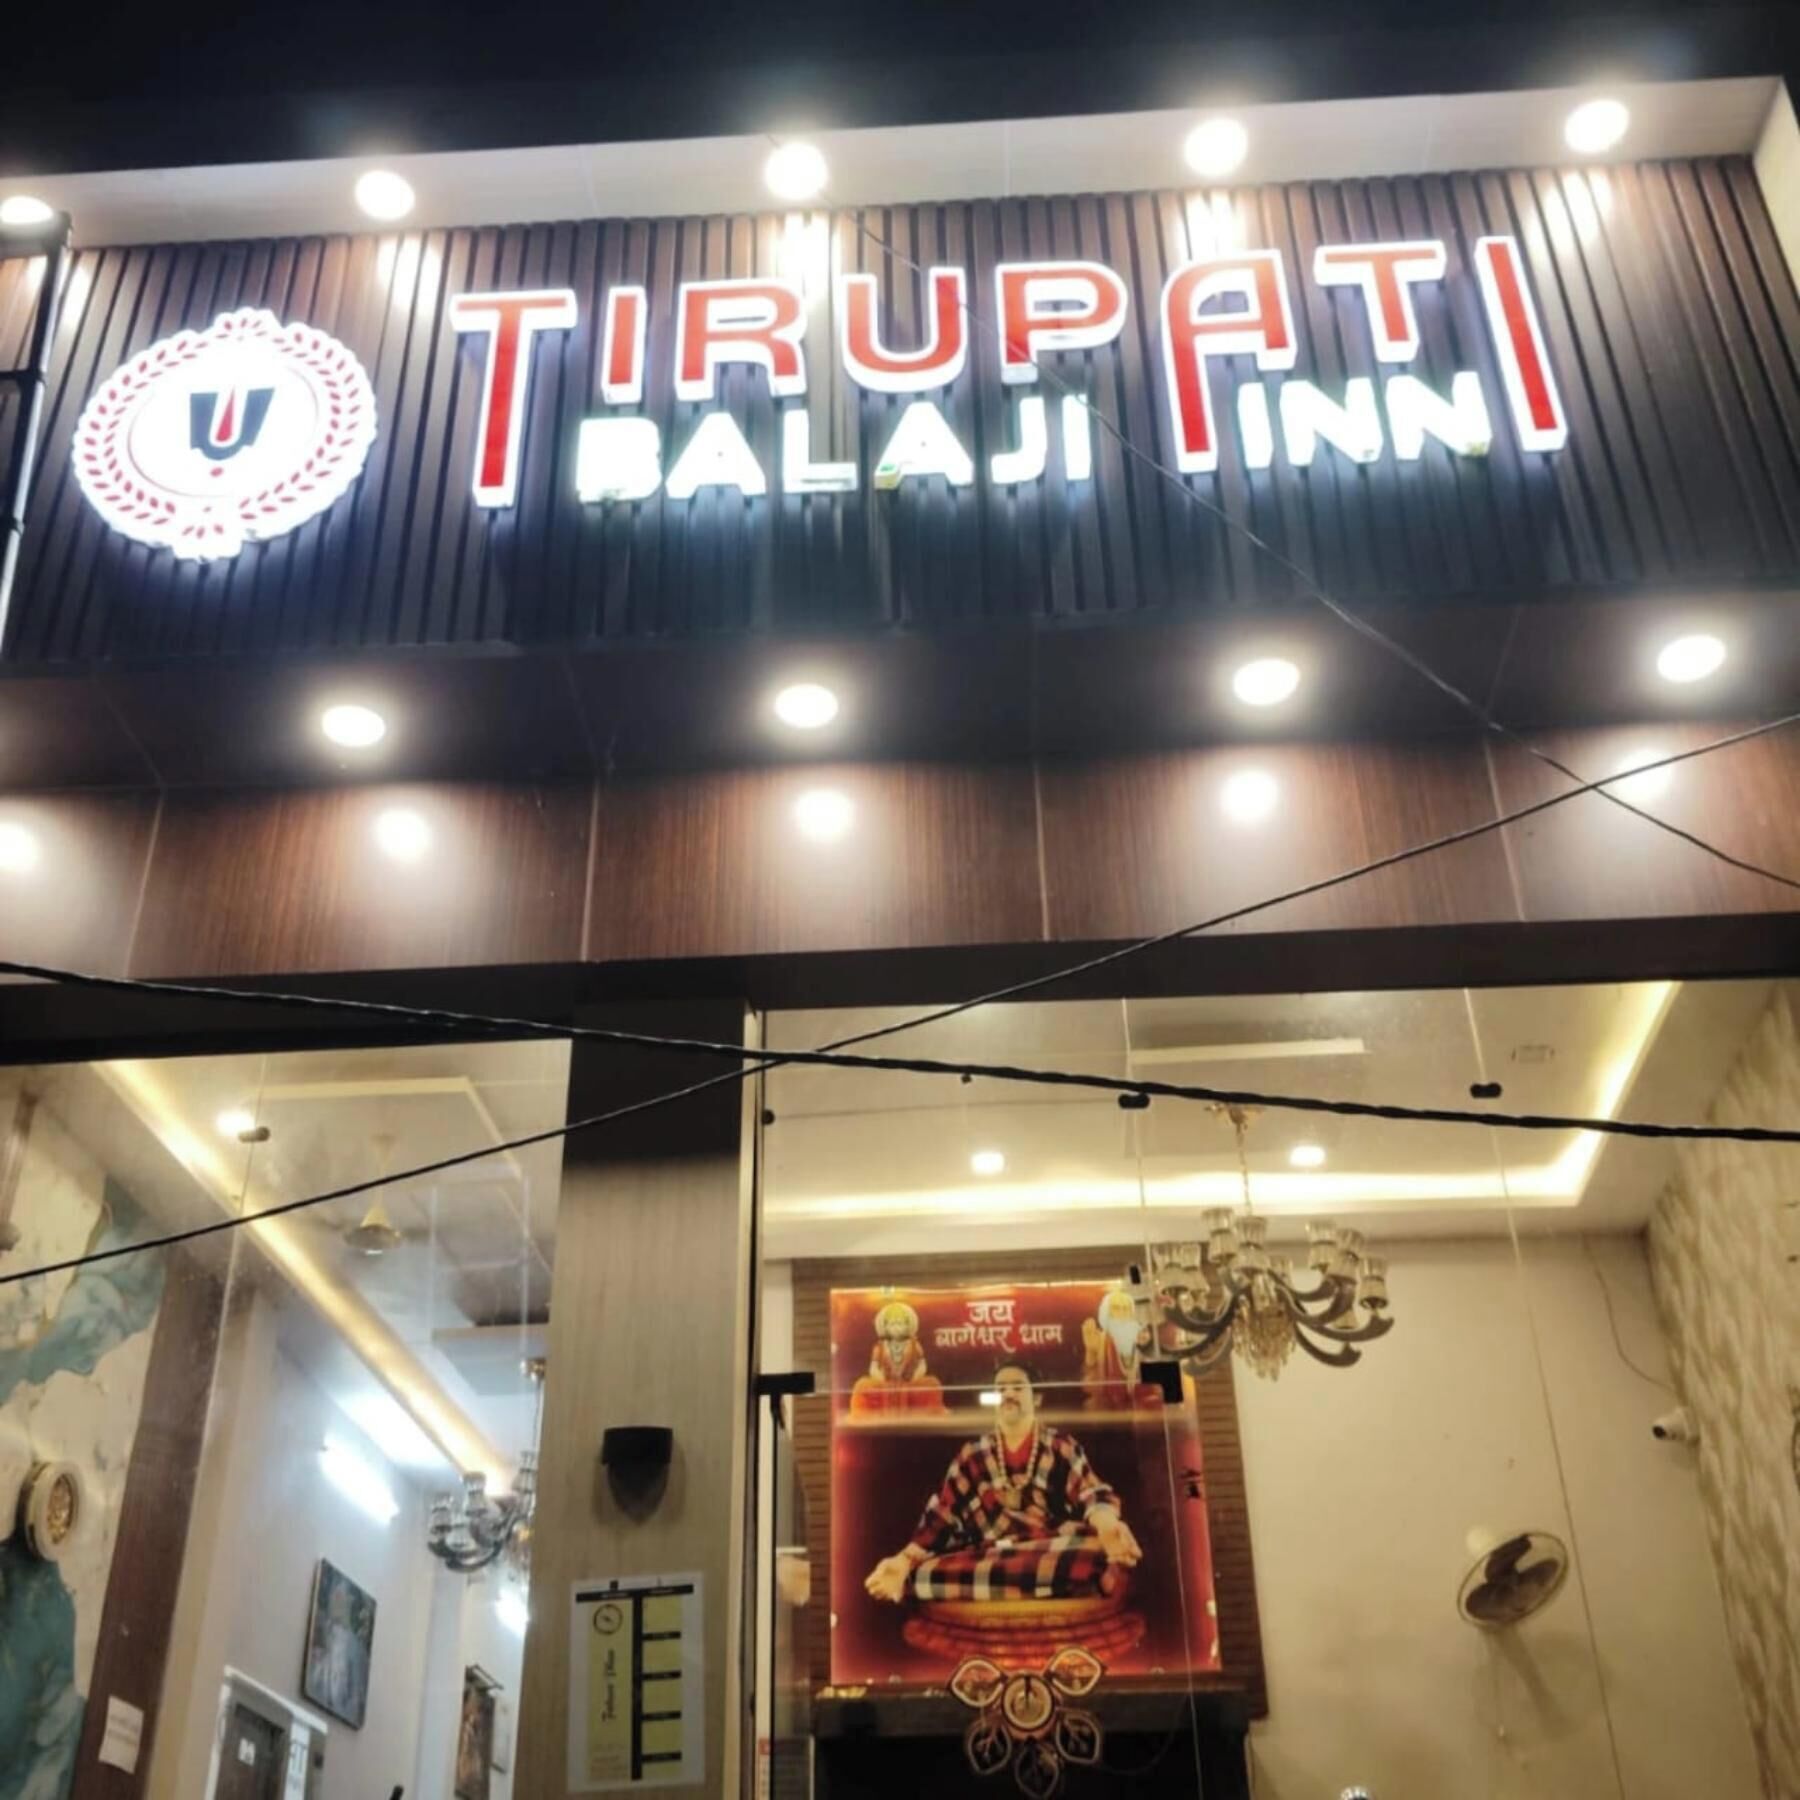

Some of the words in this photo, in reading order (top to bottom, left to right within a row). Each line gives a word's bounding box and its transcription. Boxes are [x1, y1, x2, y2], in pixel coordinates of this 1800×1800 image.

[449, 236, 1568, 508] TIRUPATI
[575, 394, 1091, 504] BALAJI
[1237, 371, 1492, 470] INN
[966, 1299, 1015, 1324] जय
[1019, 1322, 1063, 1344] धाम
